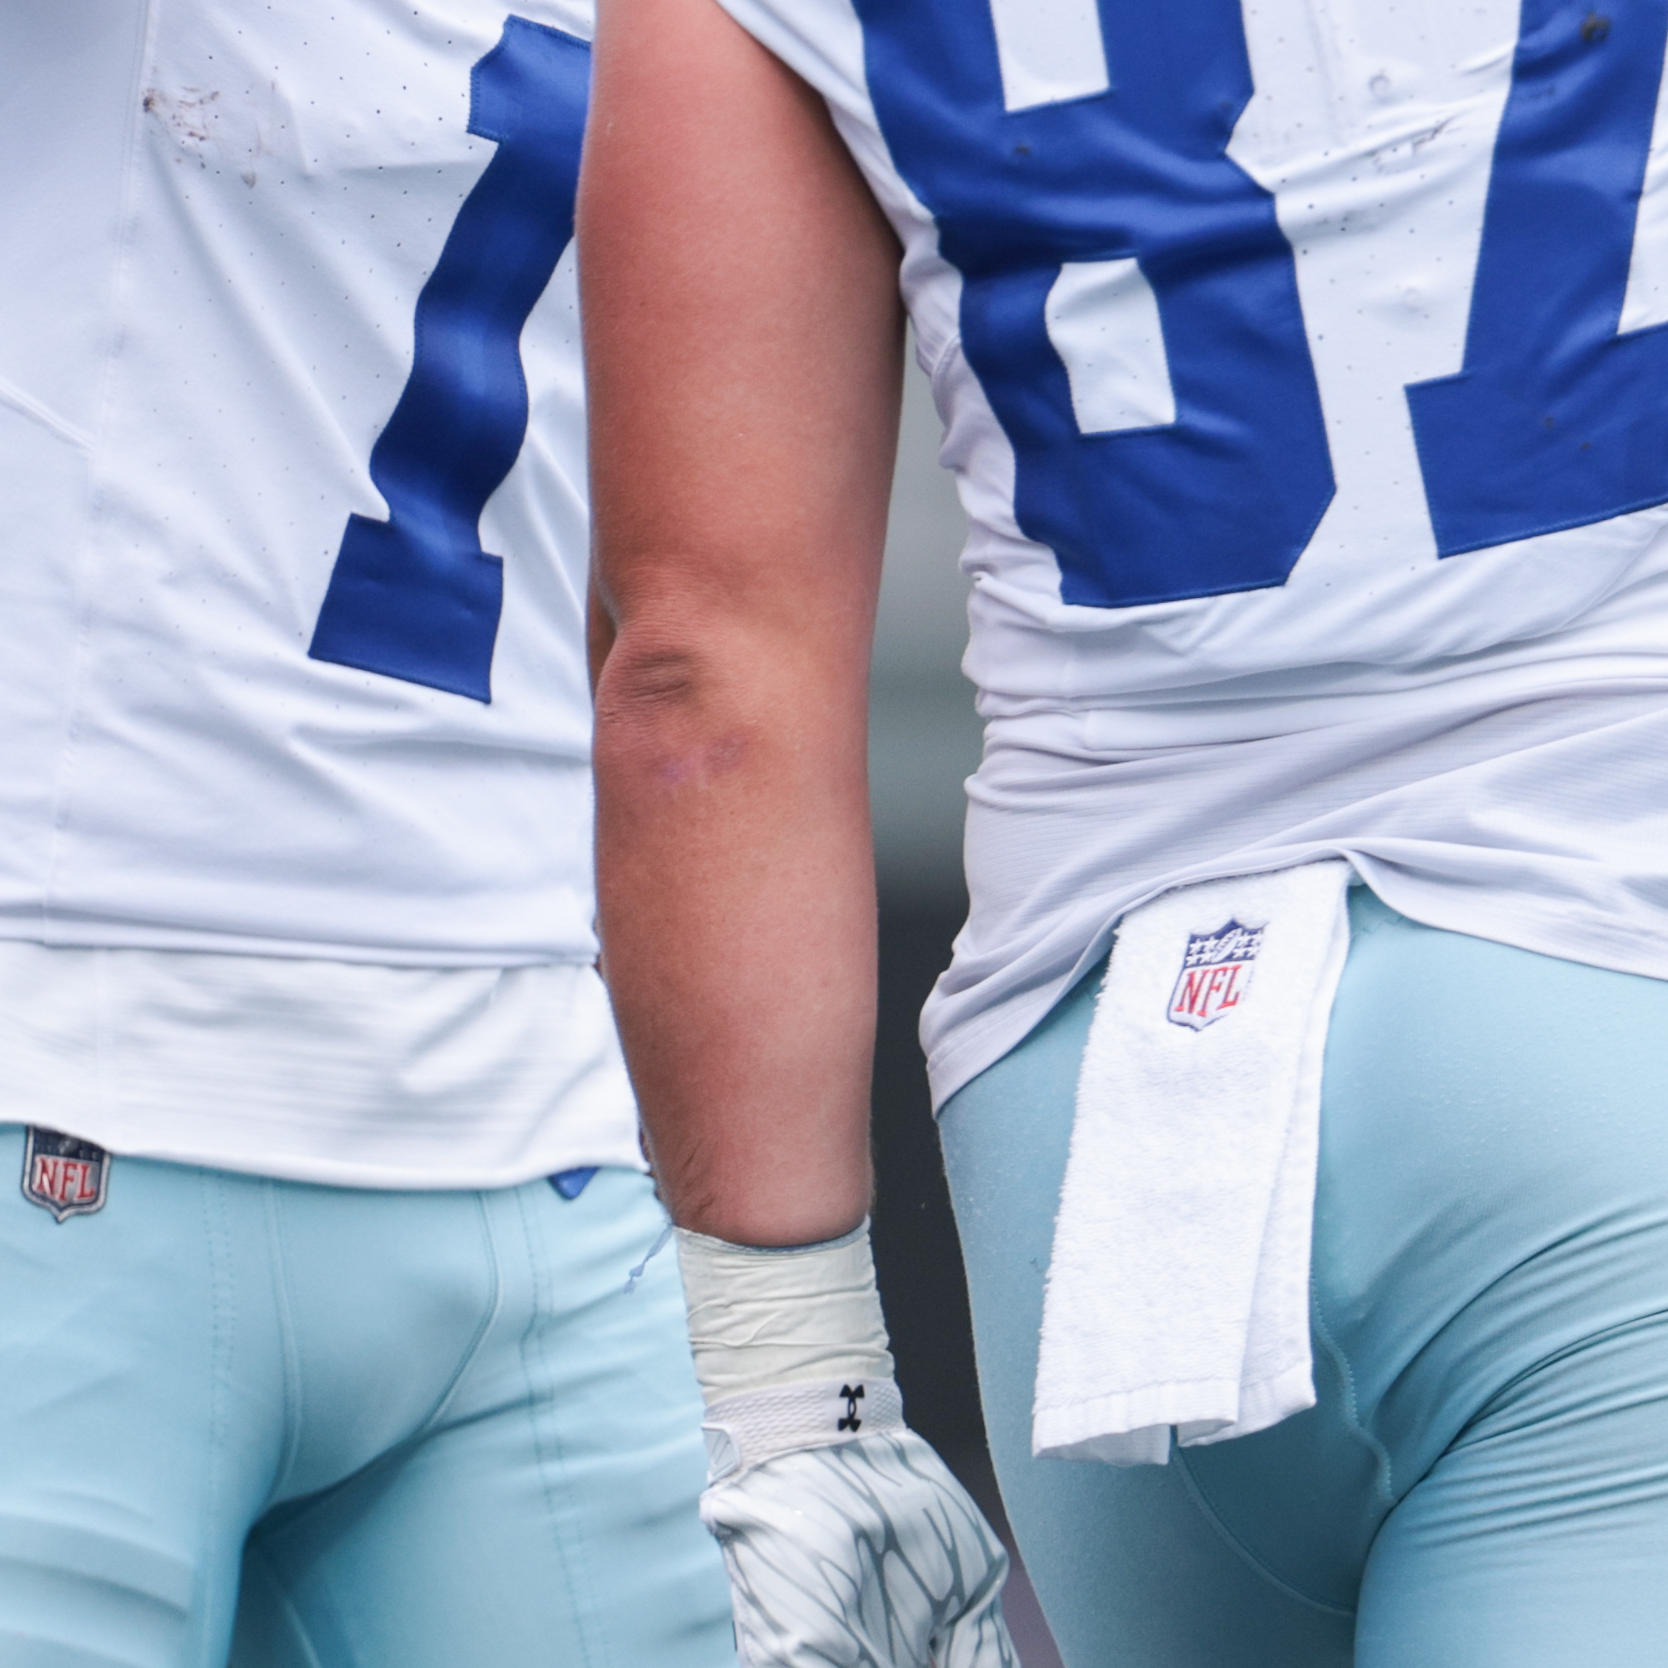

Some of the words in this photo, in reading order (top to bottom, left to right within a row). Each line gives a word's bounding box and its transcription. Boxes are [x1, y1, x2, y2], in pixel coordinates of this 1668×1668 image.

[307, 13, 594, 705] 1
[1175, 964, 1243, 1018] NFL
[35, 1158, 96, 1202] NFL
